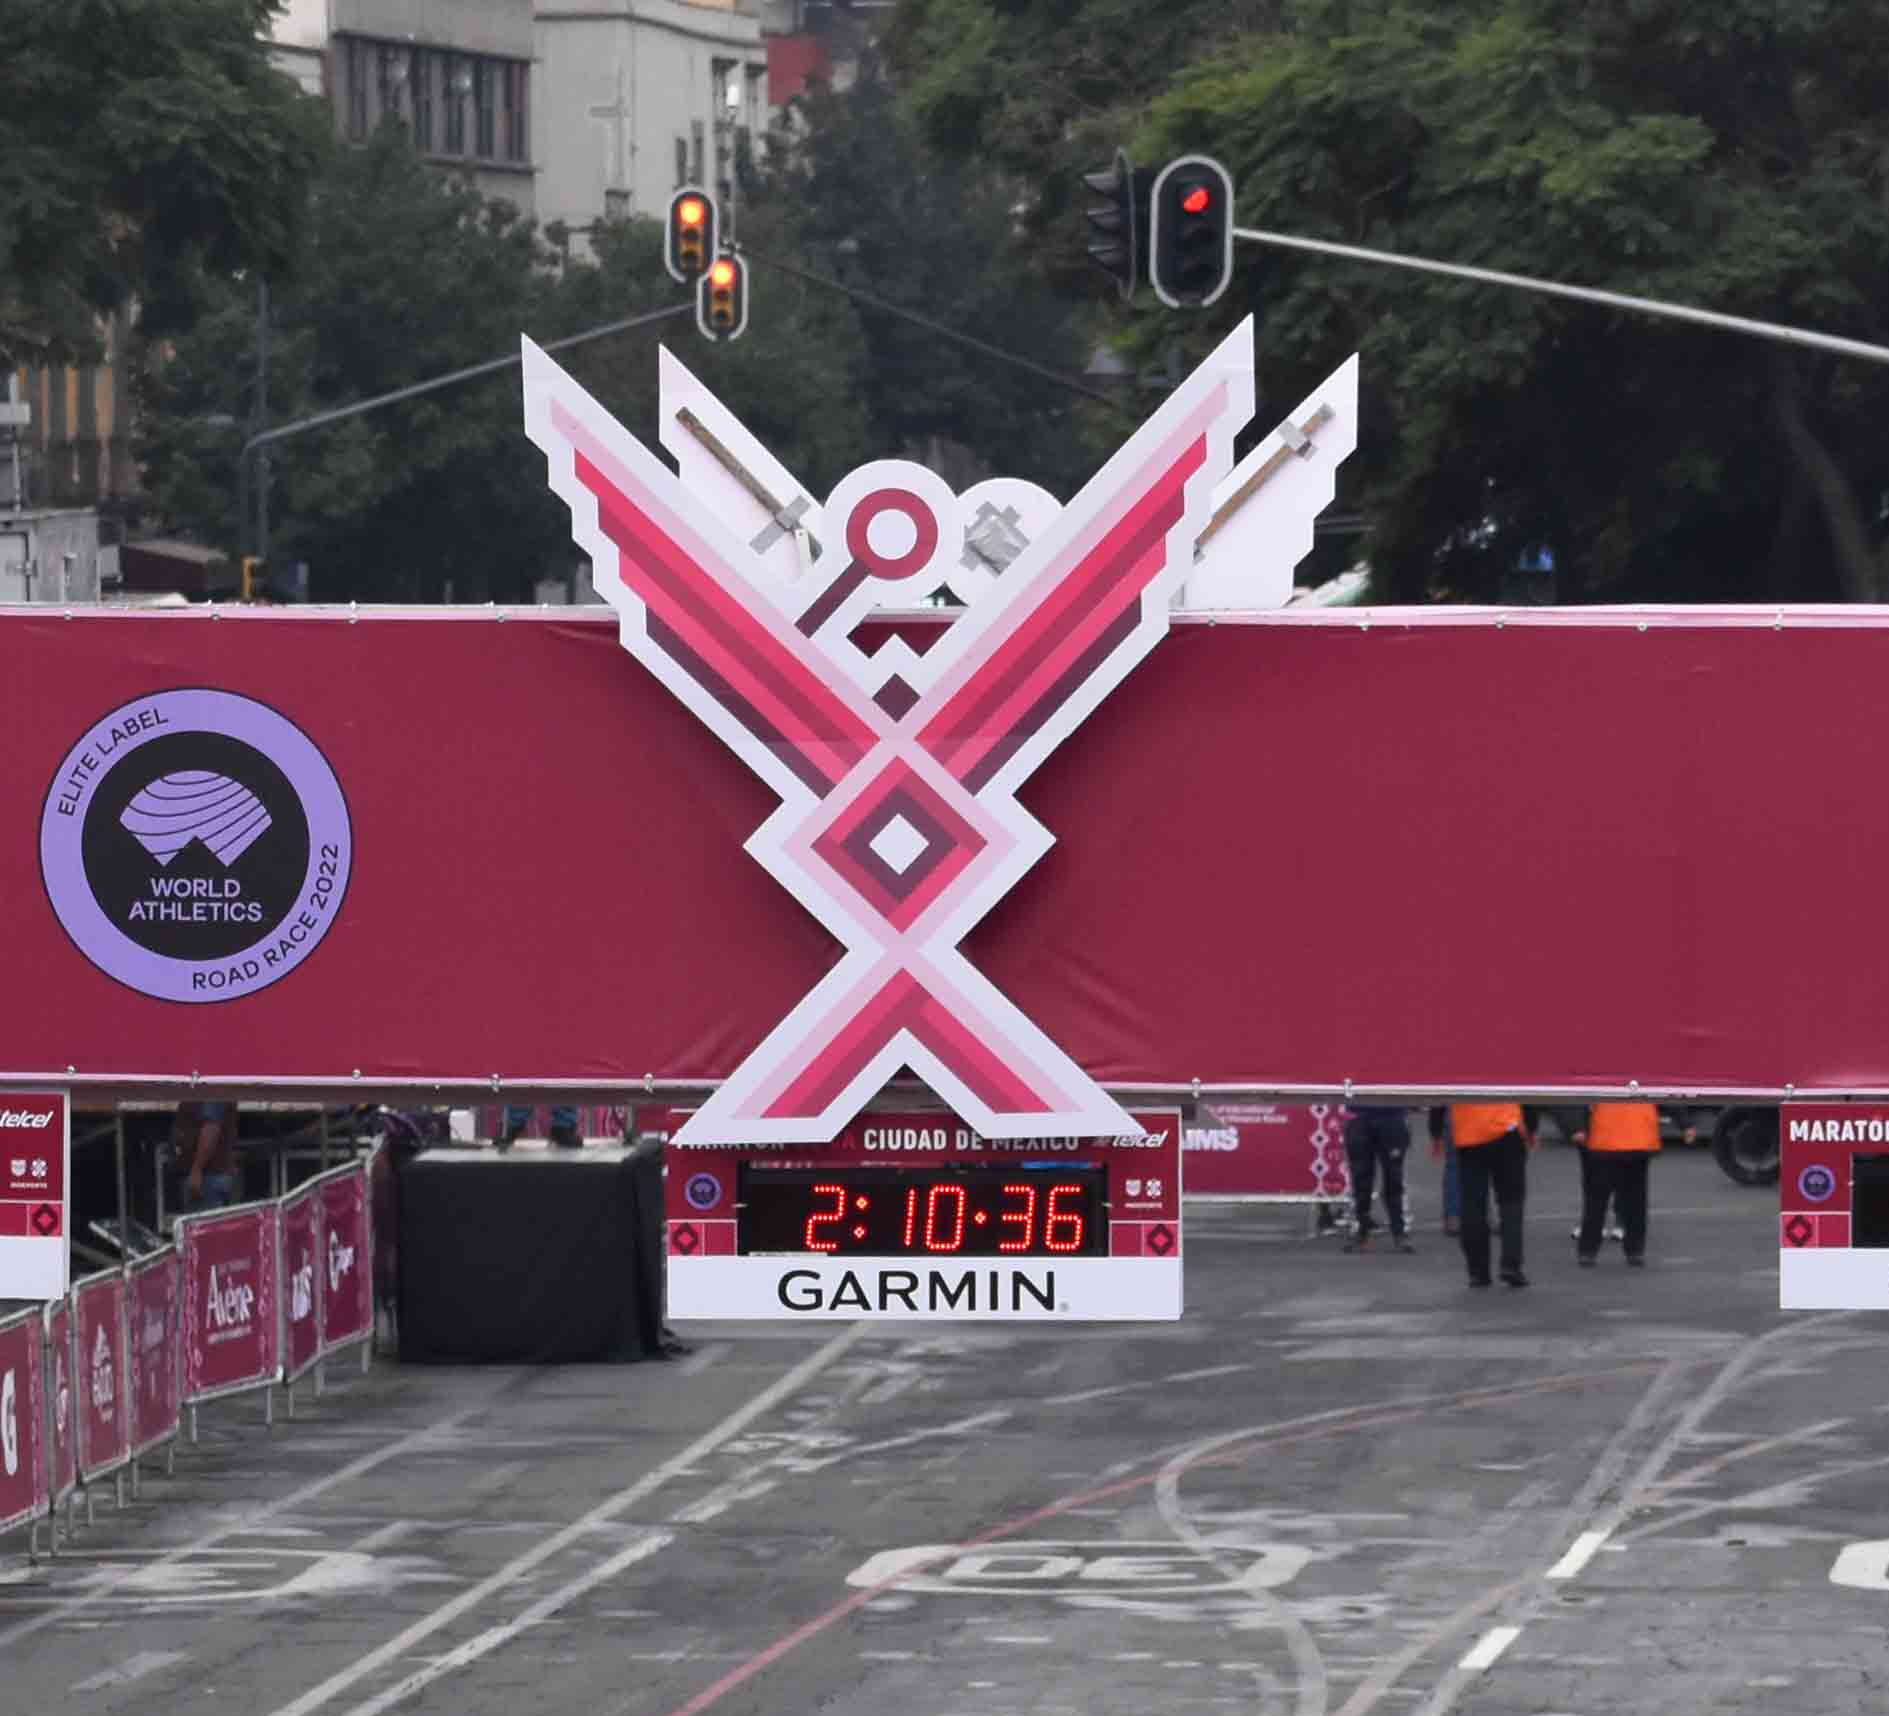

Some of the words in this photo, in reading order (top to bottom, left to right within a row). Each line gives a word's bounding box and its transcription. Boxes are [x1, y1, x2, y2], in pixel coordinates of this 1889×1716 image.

[58, 752, 100, 817] ELITE
[96, 706, 170, 755] LABEL
[152, 878, 240, 898] WORLD
[128, 902, 262, 922] ATHLETICS
[192, 960, 260, 990] ROAD
[263, 911, 318, 967] RACE
[310, 843, 339, 910] 2022
[864, 1129, 947, 1151] CIUDAD
[956, 1130, 983, 1151] DE
[1183, 1127, 1238, 1151] IMS
[778, 1270, 1055, 1312] GARMIN
